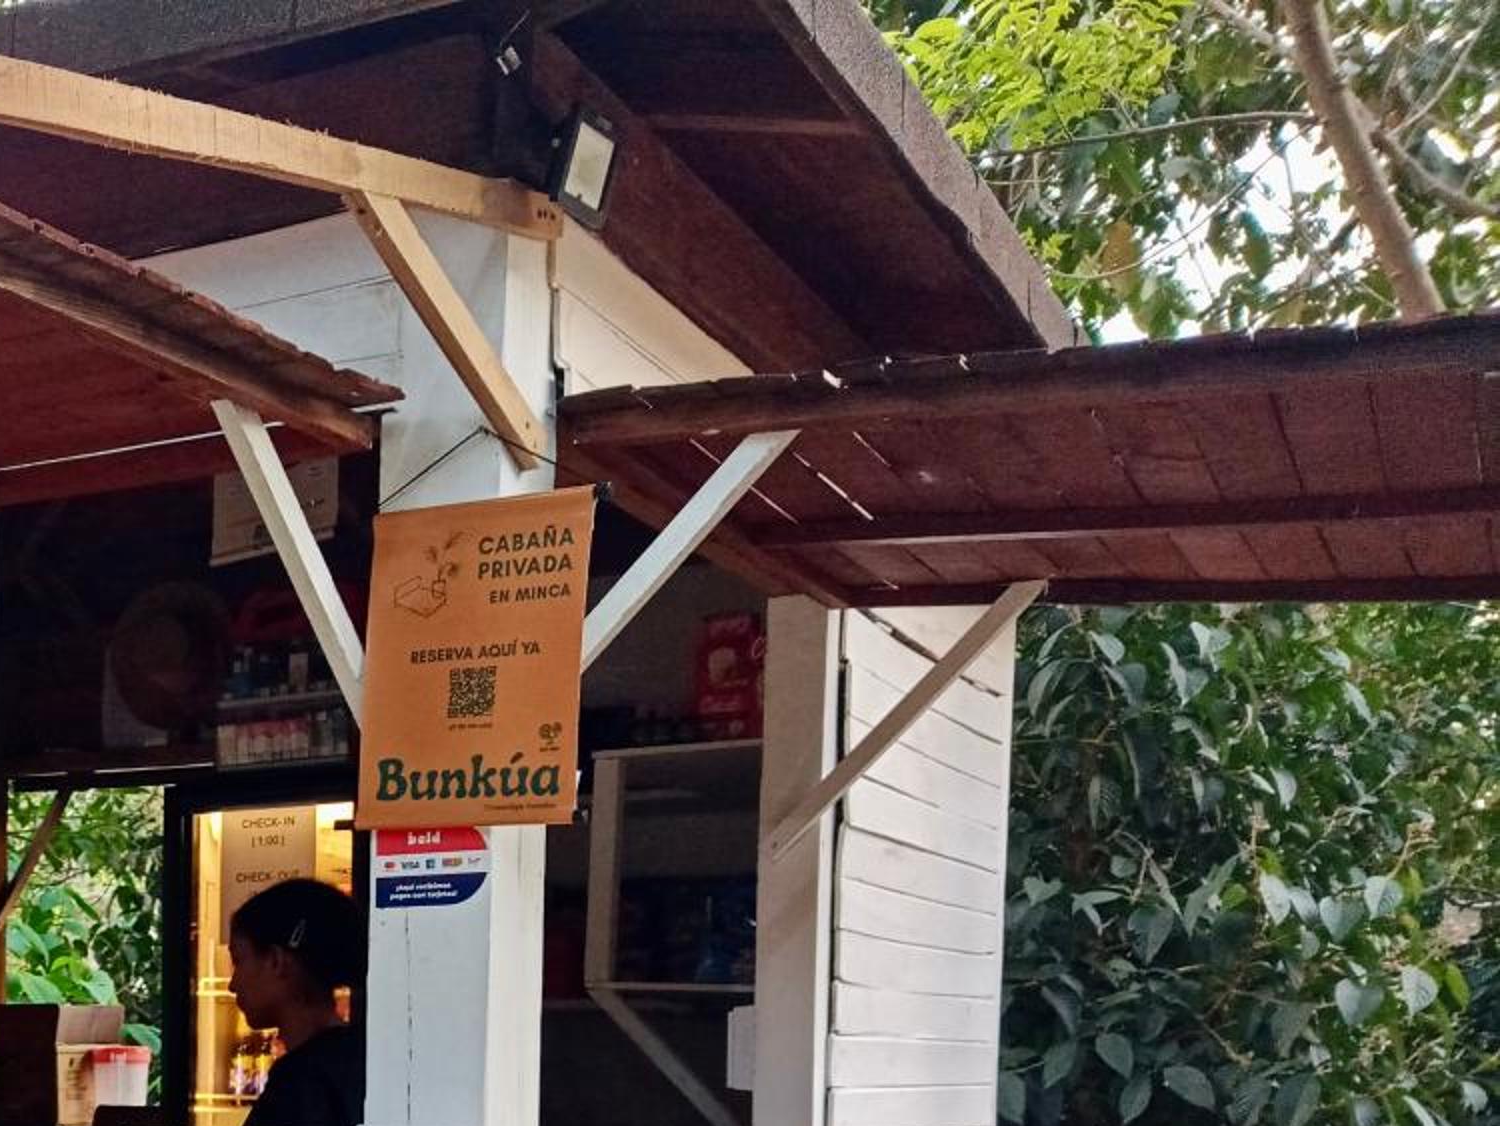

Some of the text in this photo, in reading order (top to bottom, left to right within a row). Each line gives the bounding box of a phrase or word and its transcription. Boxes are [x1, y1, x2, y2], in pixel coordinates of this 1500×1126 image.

[478, 525, 575, 555] CABAÑA
[478, 553, 573, 579] PRIVADA
[489, 583, 571, 604] EN MINCA
[410, 639, 541, 665] RESERVA AQUÍ YA
[376, 751, 561, 801] Bunkúa
[241, 816, 296, 829] CHECK-IN
[407, 831, 441, 846] bold
